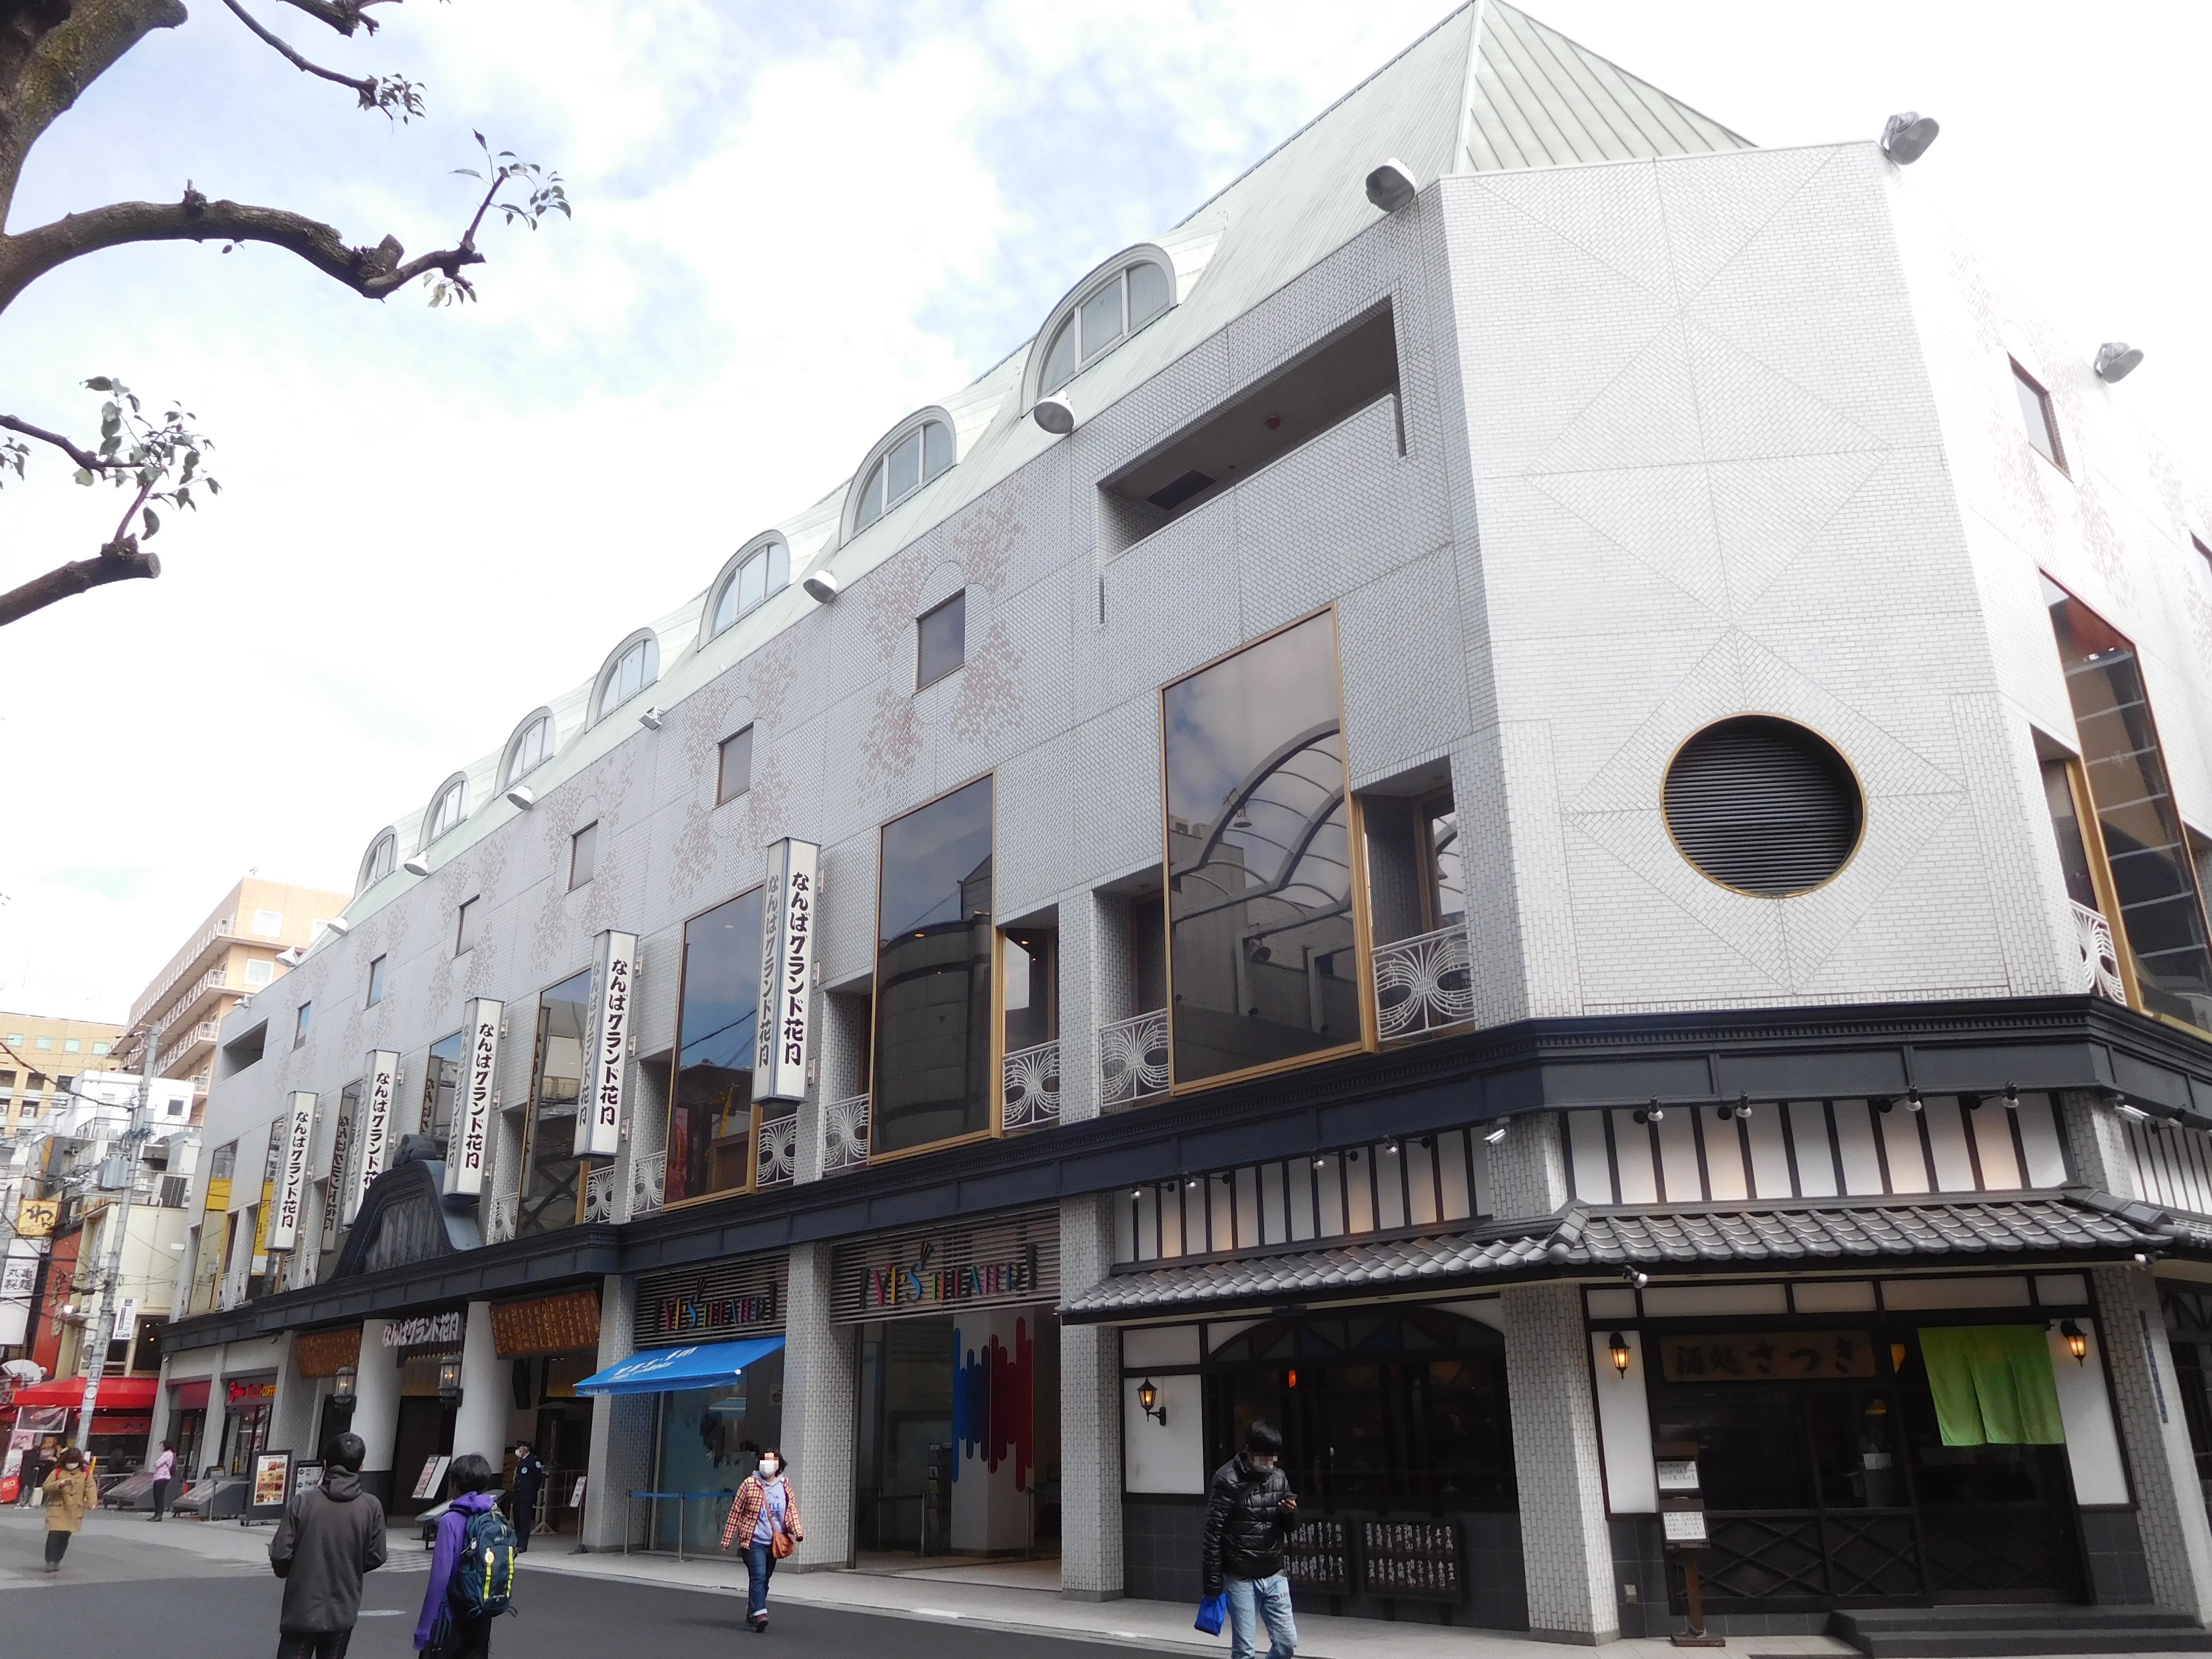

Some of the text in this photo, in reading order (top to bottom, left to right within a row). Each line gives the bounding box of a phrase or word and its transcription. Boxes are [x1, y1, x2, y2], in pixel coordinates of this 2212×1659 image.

[758, 875, 779, 1068] なんばグランド花月
[784, 871, 810, 1066] なんばグランド花月
[466, 1022, 494, 1169] なんばグランド花月
[579, 961, 601, 1127] なんばグランド花月
[600, 959, 628, 1126] なんばグランド花月
[281, 1111, 308, 1228] なんばグランド花月
[363, 1071, 390, 1189] なんばグランド花
[382, 1311, 459, 1347] なんばグランド花月
[873, 1263, 922, 1306] YES
